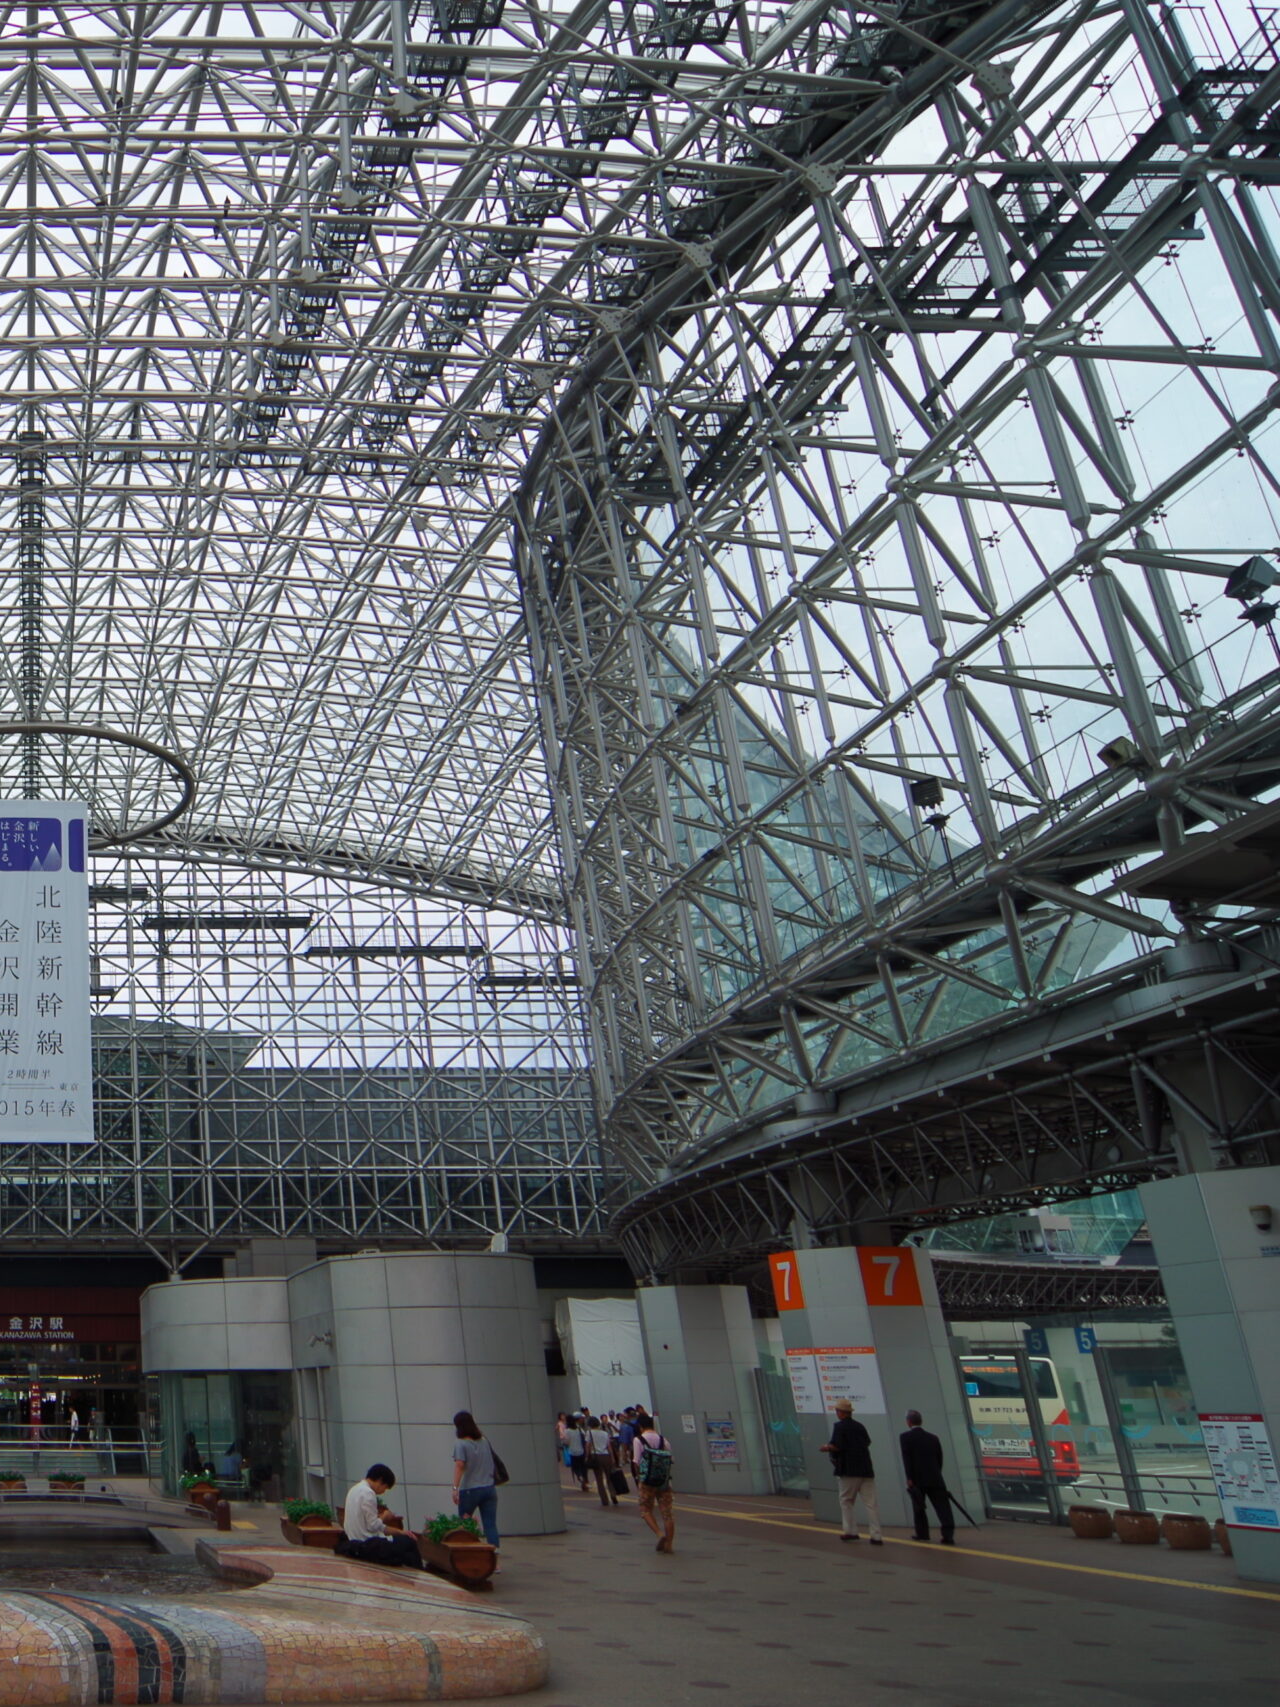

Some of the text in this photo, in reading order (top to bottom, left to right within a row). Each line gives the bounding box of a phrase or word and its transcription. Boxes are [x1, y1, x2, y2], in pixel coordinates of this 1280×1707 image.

[0, 821, 13, 867] はじまる。
[28, 821, 39, 852] 新しい
[35, 884, 64, 1056] 北陸新幹線
[7, 1068, 51, 1080] 2時間半
[776, 1261, 791, 1301] 7
[872, 1255, 901, 1297] 7
[8, 1316, 64, 1330] 金沢駅
[44, 1331, 75, 1339] STATION
[1030, 1332, 1043, 1351] 5
[1080, 1332, 1093, 1350] 5
